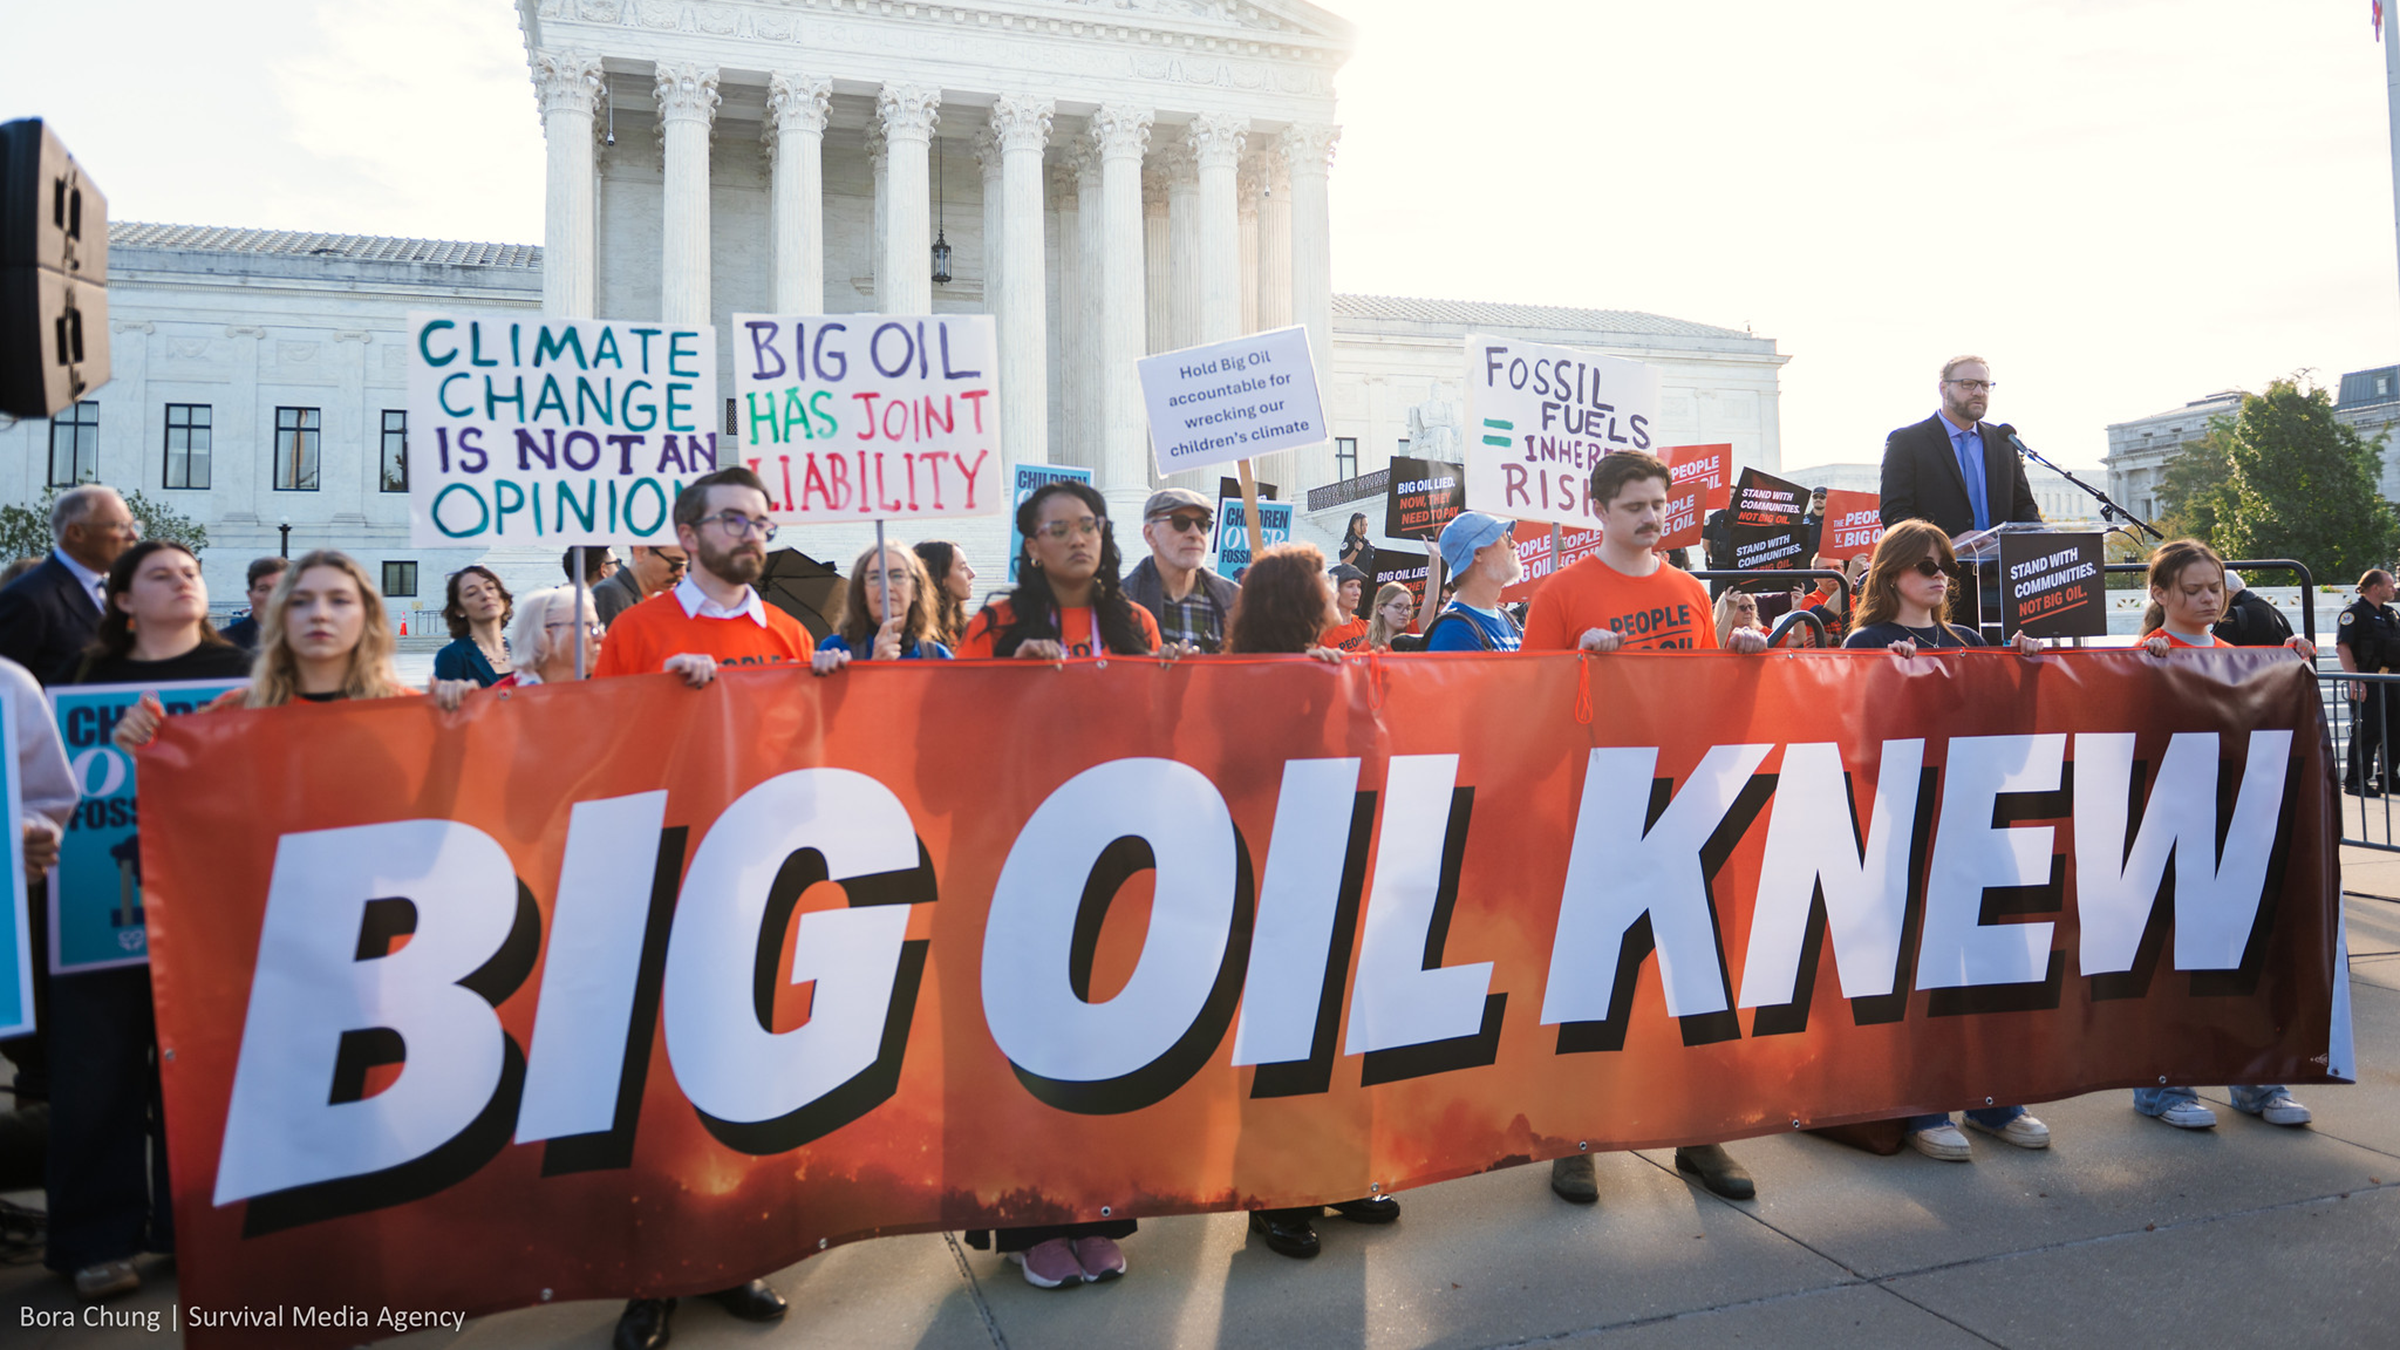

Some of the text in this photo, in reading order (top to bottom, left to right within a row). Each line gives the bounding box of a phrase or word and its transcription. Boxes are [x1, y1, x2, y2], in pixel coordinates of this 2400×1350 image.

[419, 320, 699, 377] CLIMATE
[745, 321, 982, 382] BIG OIL
[1179, 350, 1271, 379] Hold Big Oil
[1486, 347, 1614, 412] FOSSIL
[439, 373, 695, 432] CHANGE
[1169, 373, 1291, 407] accountable for
[746, 386, 989, 445] HAS JOINT
[1184, 400, 1285, 429] wrecking our
[1542, 401, 1650, 449] FUELS
[438, 427, 717, 474] IS NOT AN
[1170, 420, 1310, 457] children's climate
[1525, 435, 1613, 470] INHER
[1671, 455, 1719, 480] PEOPLE
[1397, 476, 1455, 495] BIG OIL LIED.
[1742, 488, 1794, 501] STAND WITH
[432, 477, 684, 538] OPINIO
[1400, 492, 1451, 510] NOW, THEY
[1740, 500, 1800, 514] COMMUNITIES.
[1401, 510, 1429, 525] NEED
[1430, 508, 1443, 520] TO
[1673, 513, 1696, 532] OIL
[1738, 512, 1790, 524] NOT BIG OIL.
[1834, 510, 1881, 528] THE PEOP
[1736, 534, 1791, 556] STAND WITH
[1844, 530, 1870, 547] BIG
[1738, 543, 1802, 568] COMMUNITIES.
[1776, 558, 1793, 569] OIL.
[2010, 547, 2079, 580] STAND WITH
[1377, 571, 1394, 582] BIG
[1395, 569, 1410, 580] OIL
[2014, 562, 2097, 598] COMMUNITIES.
[2018, 585, 2088, 617] NOT BIG OIL.
[1609, 604, 1691, 636] PEOPLE
[212, 730, 2293, 1208] BIG OIL KNEW
